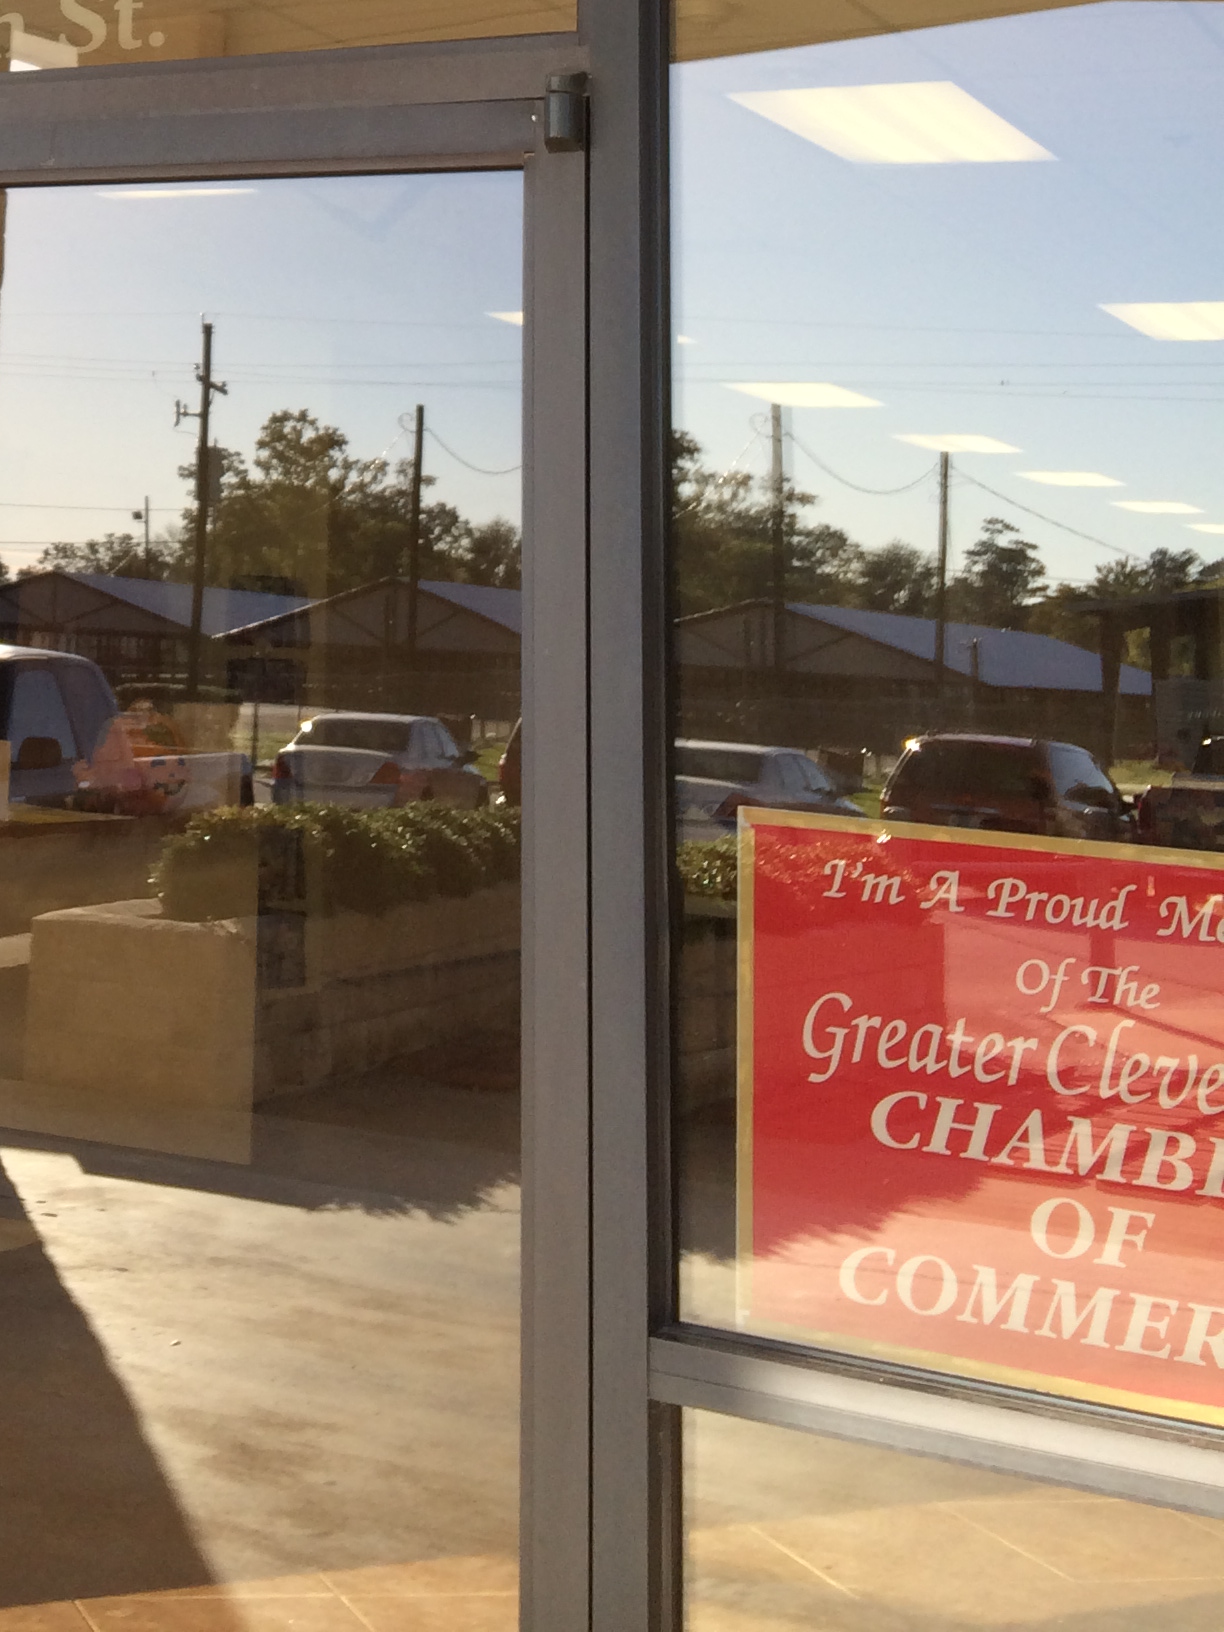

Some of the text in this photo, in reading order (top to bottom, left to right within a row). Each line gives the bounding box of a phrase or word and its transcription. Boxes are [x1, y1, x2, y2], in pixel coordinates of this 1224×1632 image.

[824, 860, 904, 905] I'm
[921, 870, 965, 913] A
[987, 878, 1136, 931] Proud
[1017, 958, 1160, 1011] Of The
[803, 993, 1037, 1082] Greater
[1031, 1198, 1155, 1268] OF
[839, 1247, 1224, 1369] COMMER
